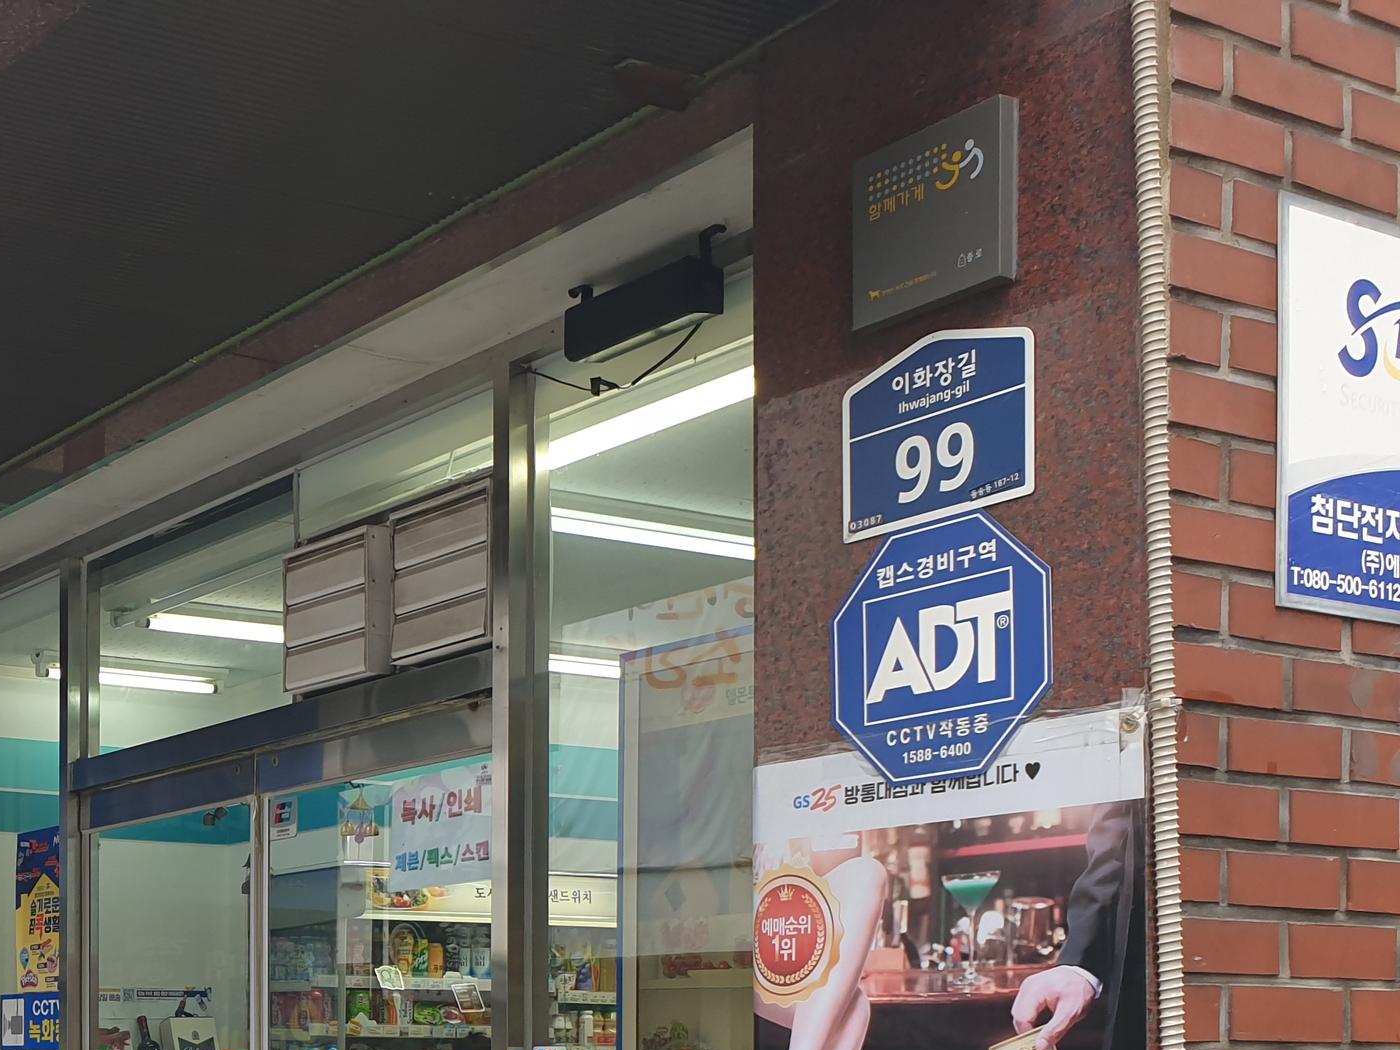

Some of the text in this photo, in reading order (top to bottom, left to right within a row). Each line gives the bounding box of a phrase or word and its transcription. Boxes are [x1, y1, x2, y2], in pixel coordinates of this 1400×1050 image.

[891, 349, 977, 395] 이화장길
[898, 380, 970, 414] Ihwajang-gil
[895, 421, 975, 504] 99
[849, 514, 883, 531] 03087
[876, 538, 997, 589] 캡스경비구역
[865, 590, 1012, 704] ADT
[886, 713, 990, 746] CCTV작동중
[902, 741, 972, 765] 1588-6400
[793, 784, 842, 813] GS25
[549, 889, 592, 904] 샌드위치
[761, 912, 812, 937] 예매순위
[771, 936, 798, 962] 1위
